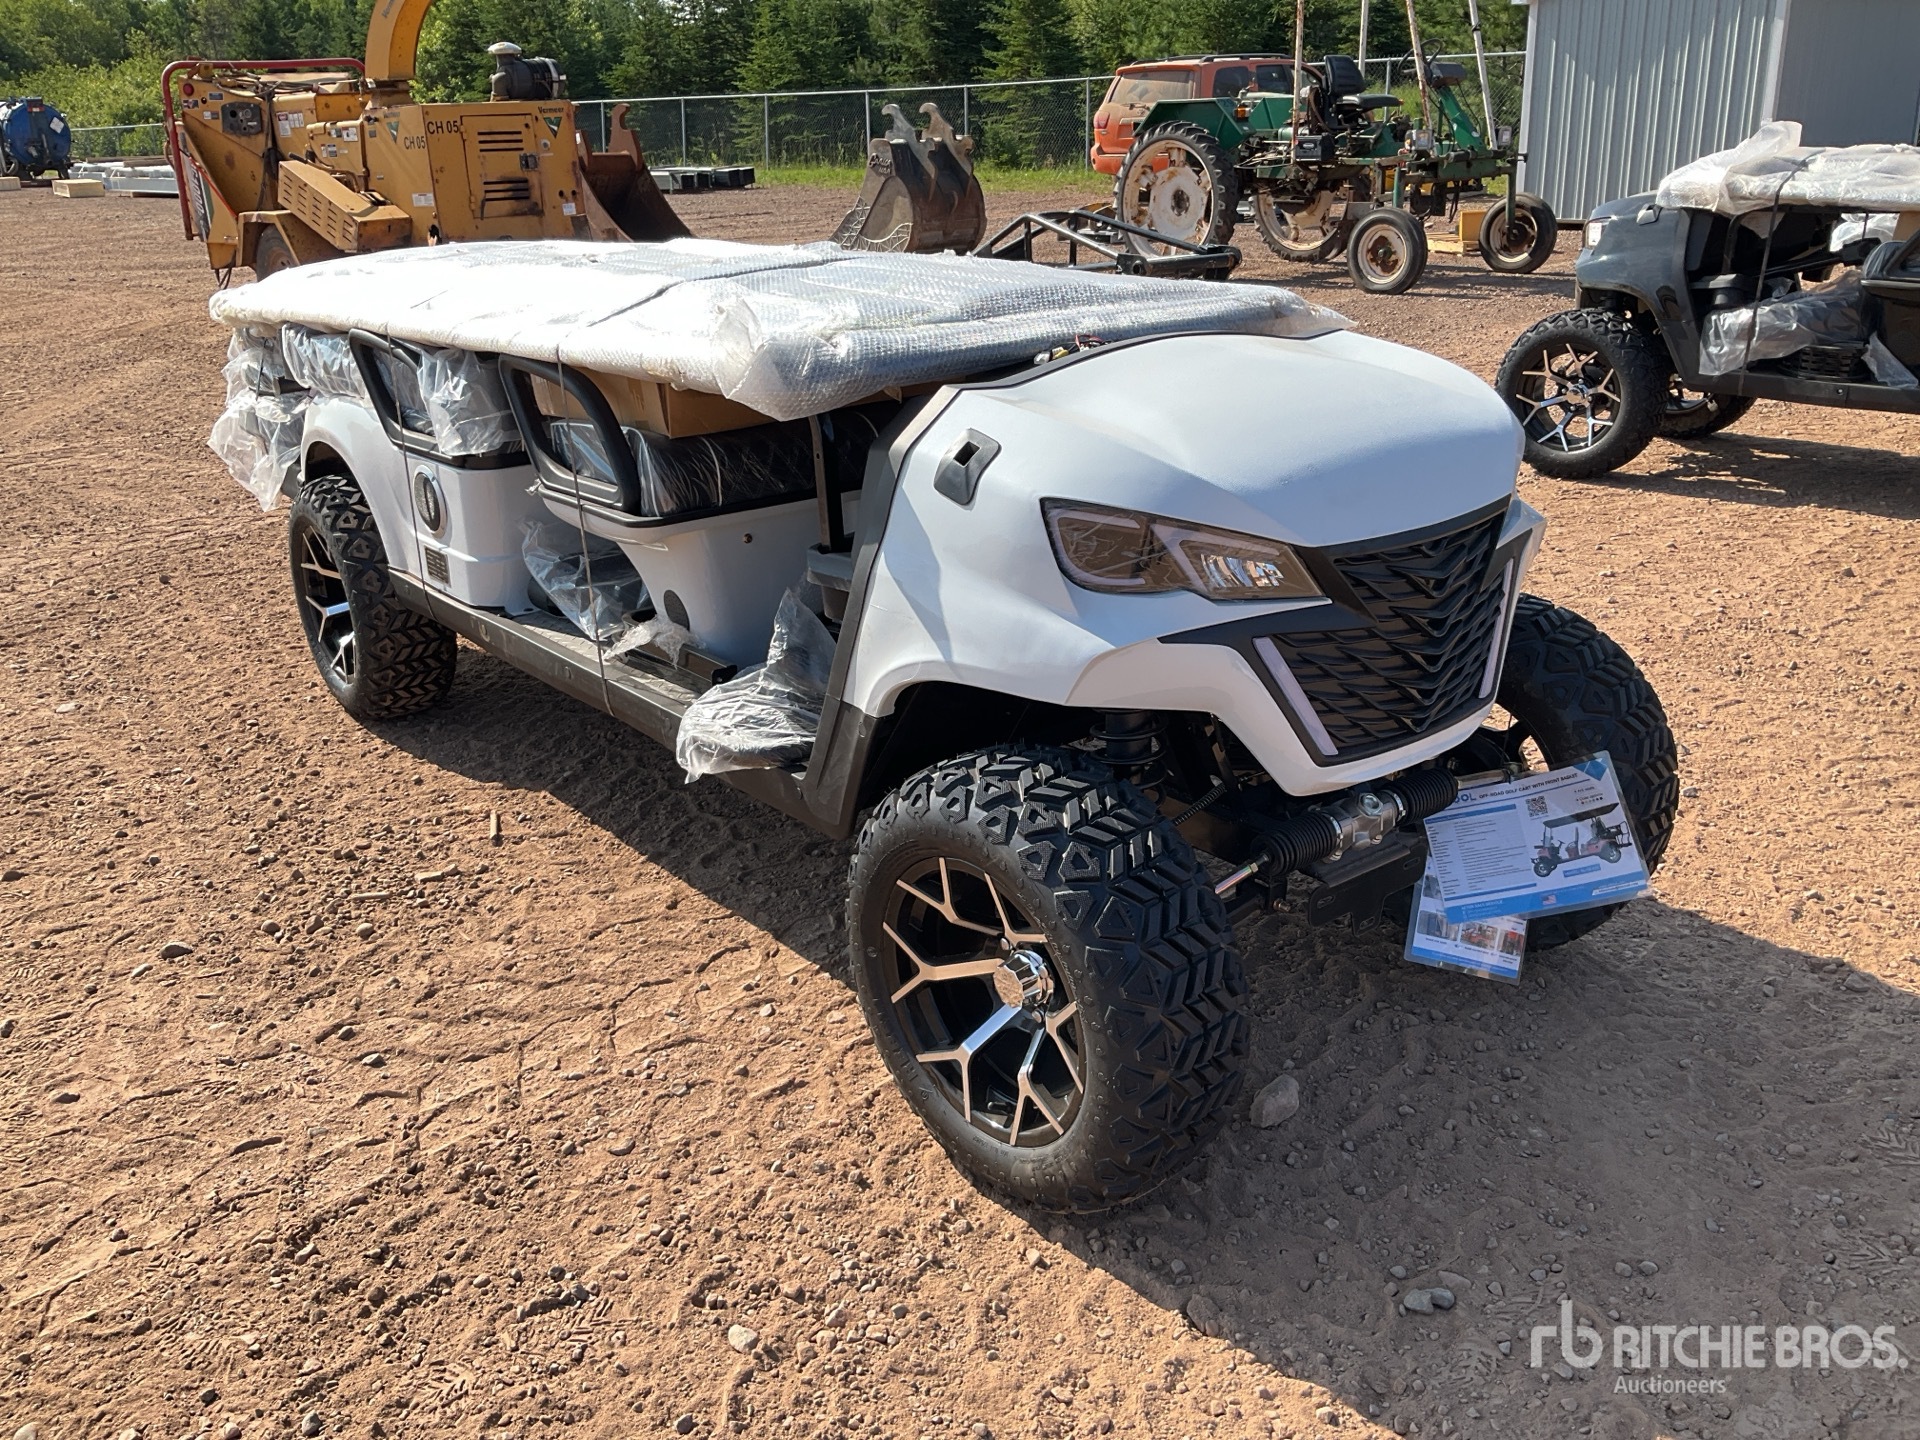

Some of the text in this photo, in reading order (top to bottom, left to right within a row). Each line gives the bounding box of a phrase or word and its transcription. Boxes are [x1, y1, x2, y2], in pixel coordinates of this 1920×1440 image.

[538, 106, 564, 114] Vermeer
[427, 120, 459, 135] CH 05
[404, 136, 426, 150] CH 05
[1545, 777, 1560, 785] FRONT
[1560, 772, 1578, 781] BASKET
